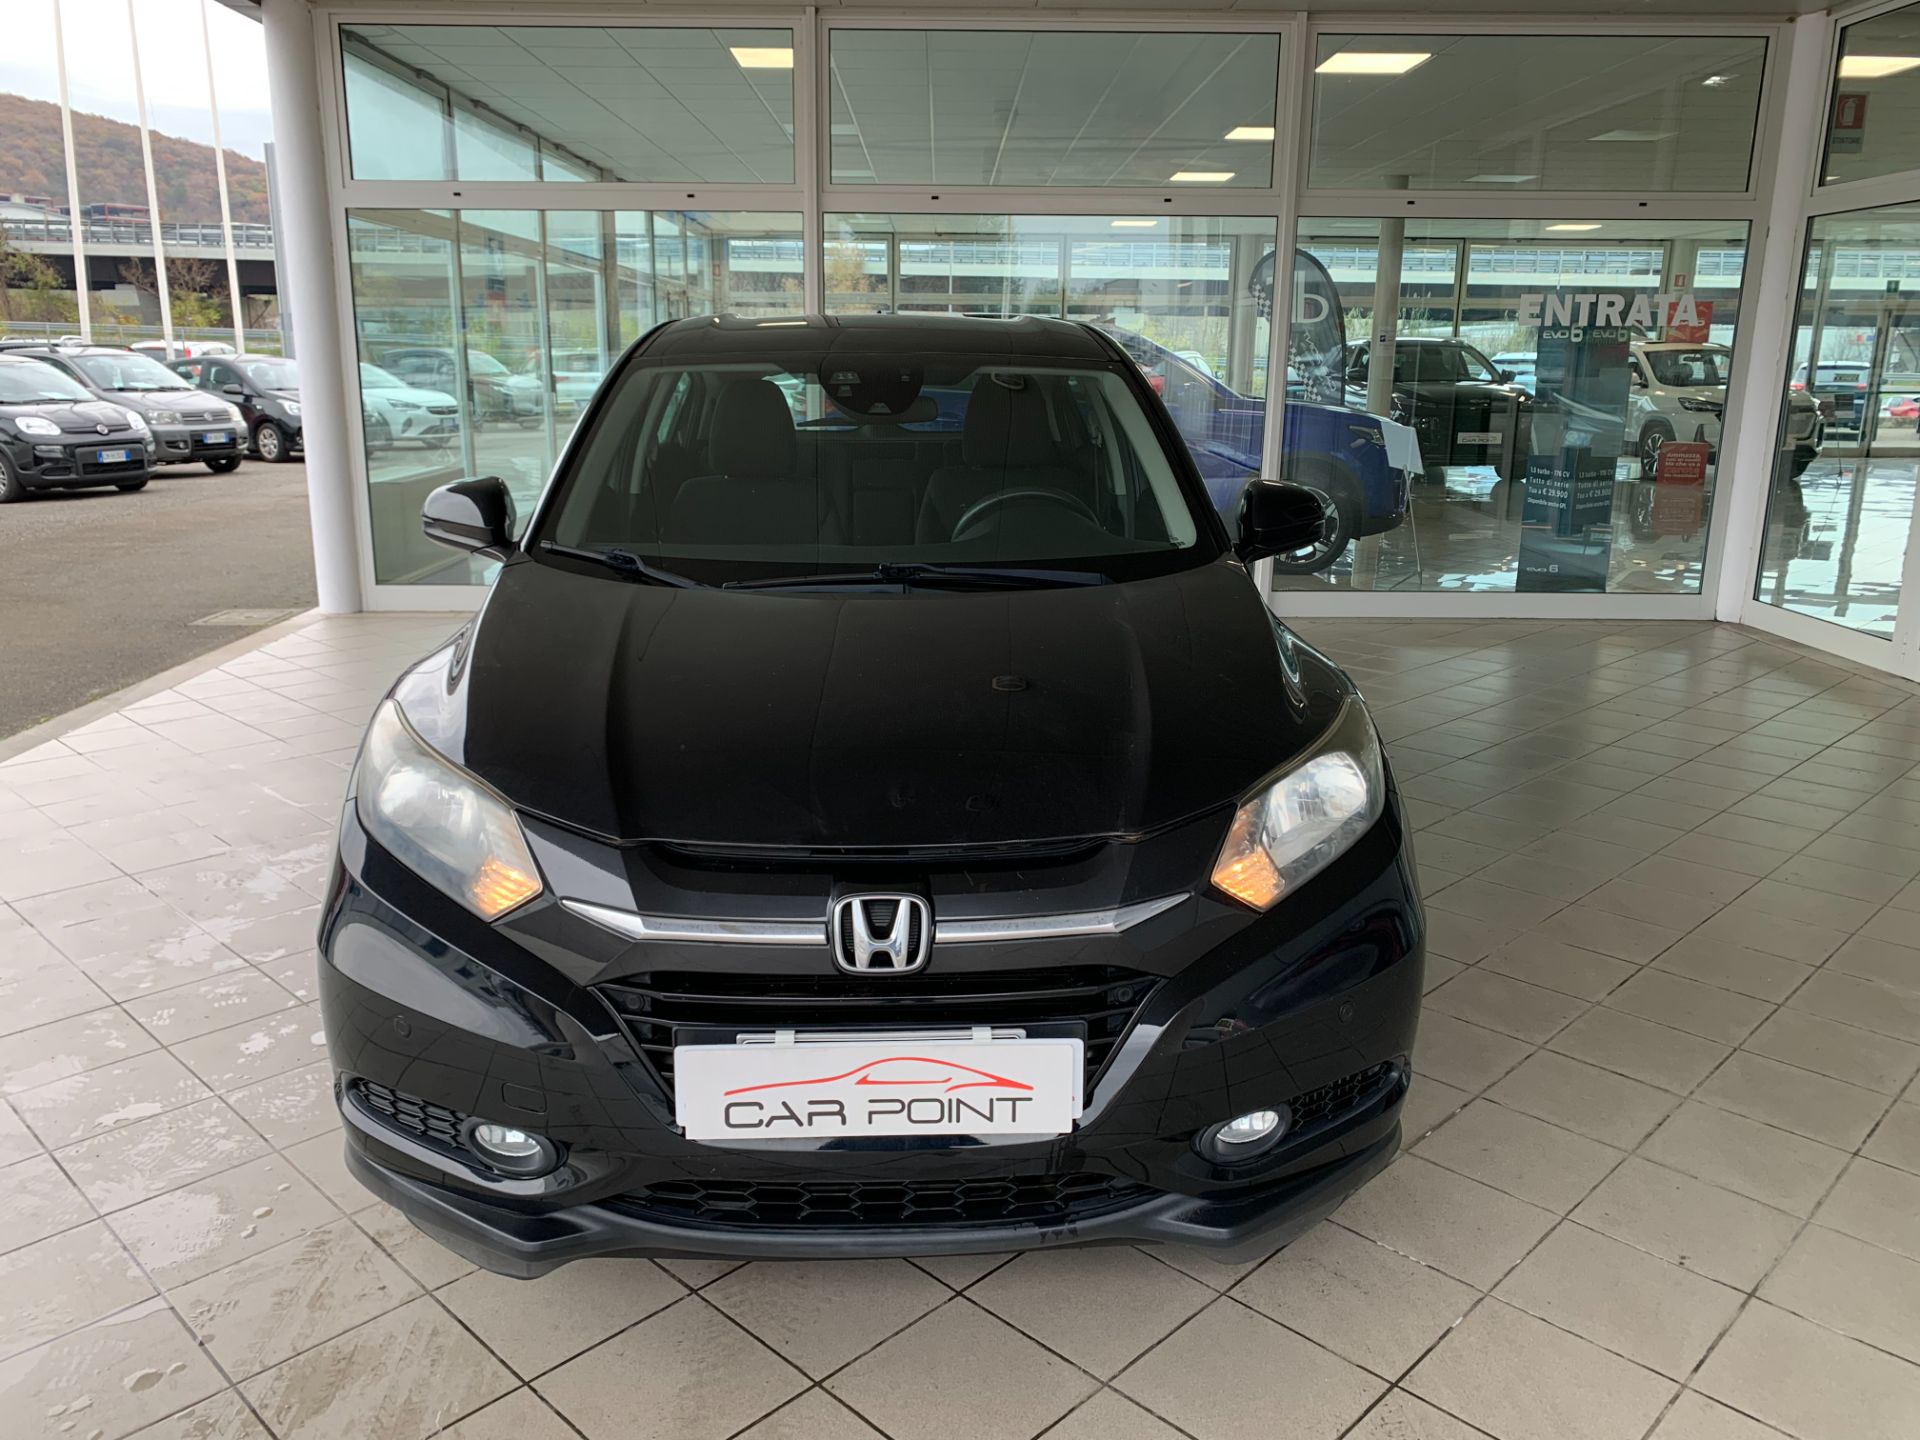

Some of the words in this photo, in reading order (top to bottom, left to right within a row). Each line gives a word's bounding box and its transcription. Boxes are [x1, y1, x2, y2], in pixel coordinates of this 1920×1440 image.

[1519, 294, 1698, 326] ENTRATA
[724, 1100, 847, 1129] CAR
[867, 1097, 1033, 1125] POINT
